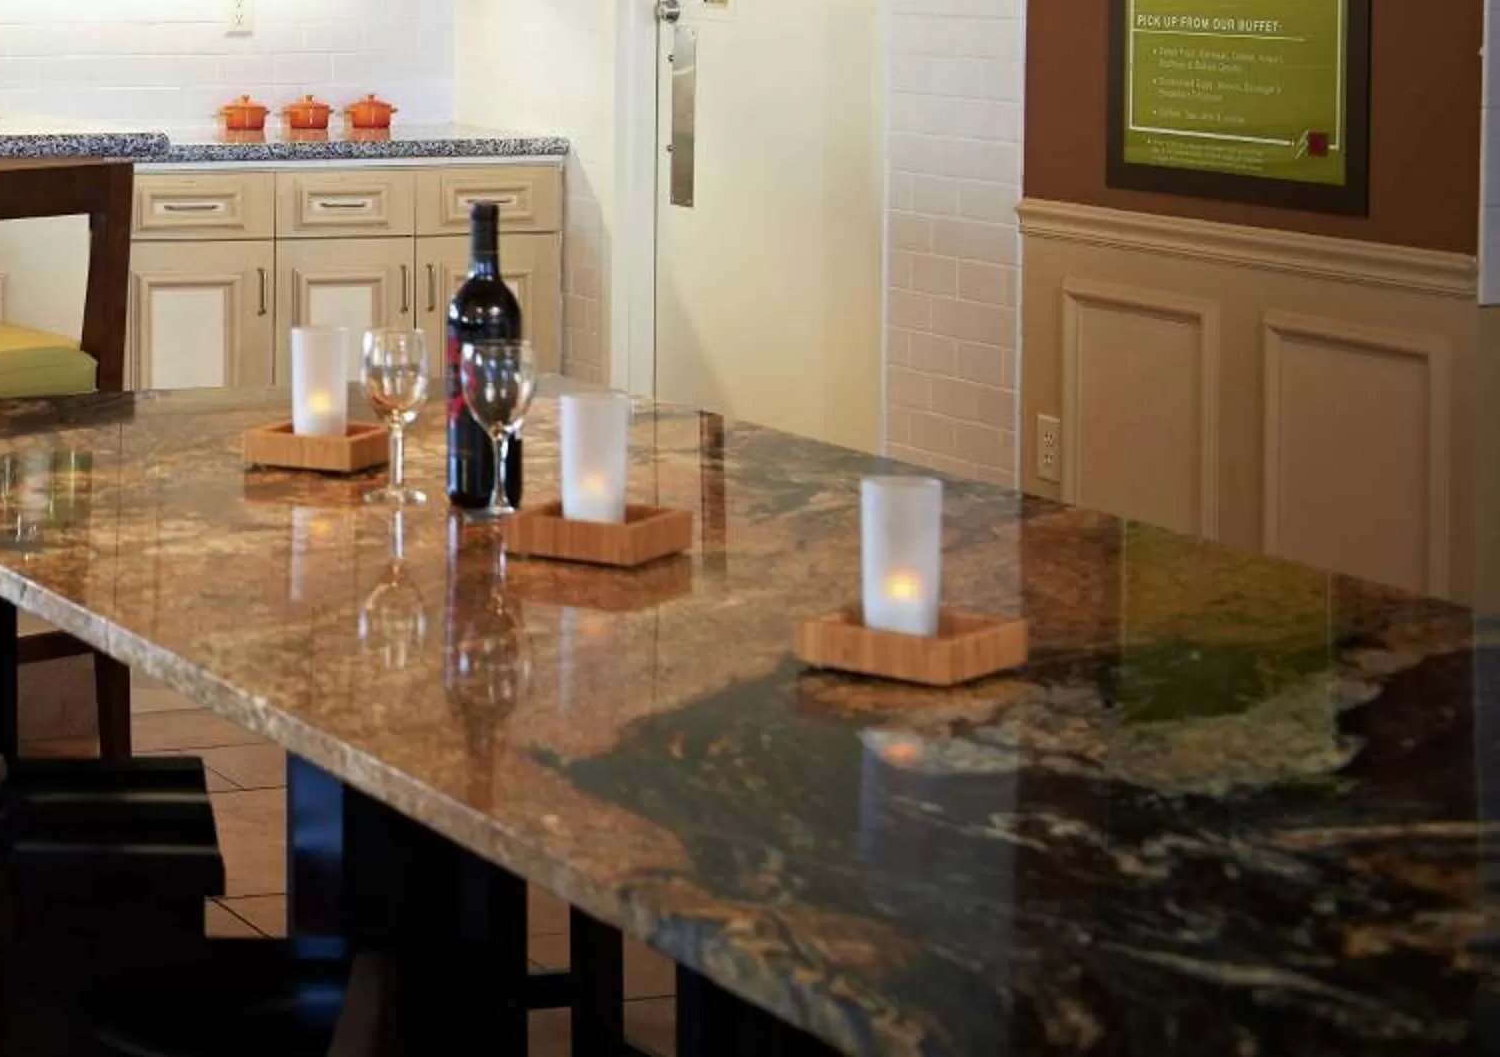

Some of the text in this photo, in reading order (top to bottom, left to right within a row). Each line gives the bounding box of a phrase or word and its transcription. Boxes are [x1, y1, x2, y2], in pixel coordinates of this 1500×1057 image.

[1137, 14, 1160, 26] PICK
[1164, 16, 1178, 28] UP
[1180, 16, 1210, 30] FROM
[1213, 18, 1235, 31] OUR
